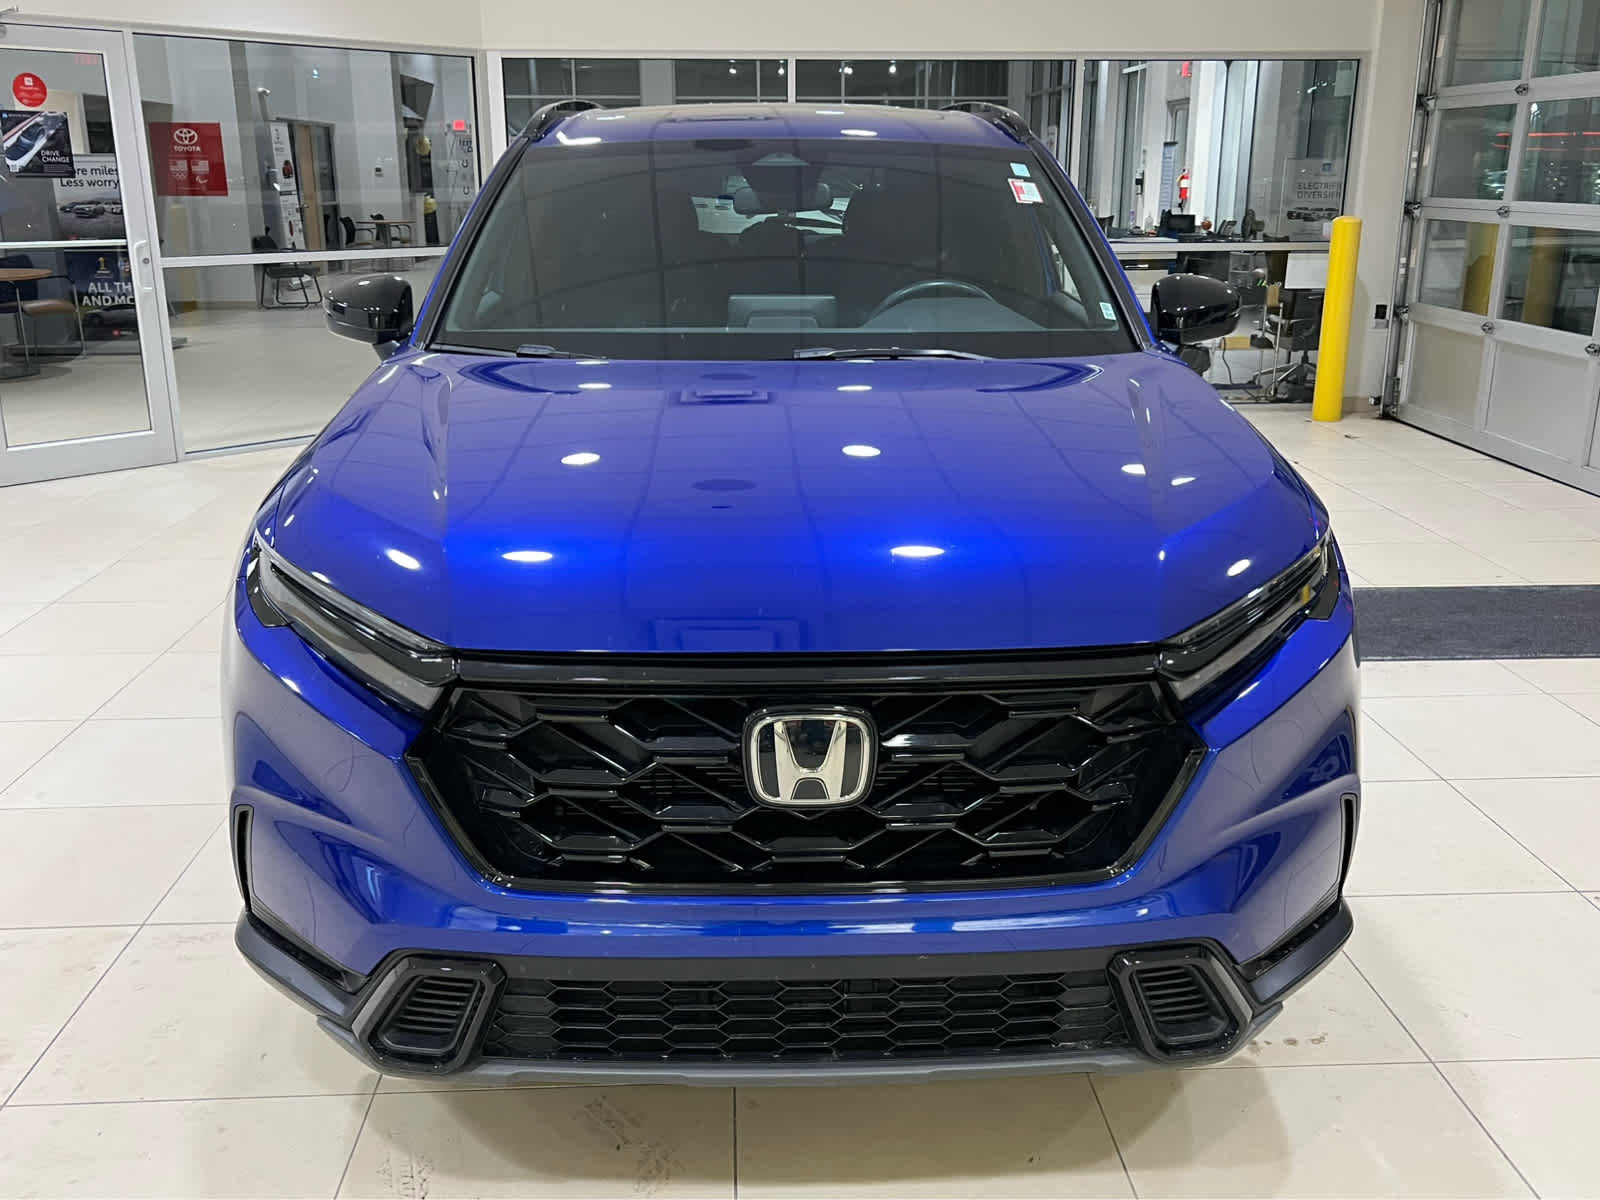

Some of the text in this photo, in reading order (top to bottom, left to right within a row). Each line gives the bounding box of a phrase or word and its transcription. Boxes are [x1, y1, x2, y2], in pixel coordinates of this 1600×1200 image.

[75, 167, 88, 175] re
[60, 178, 119, 190] Less worry
[88, 281, 112, 293] ALL
[82, 295, 111, 306] AND
